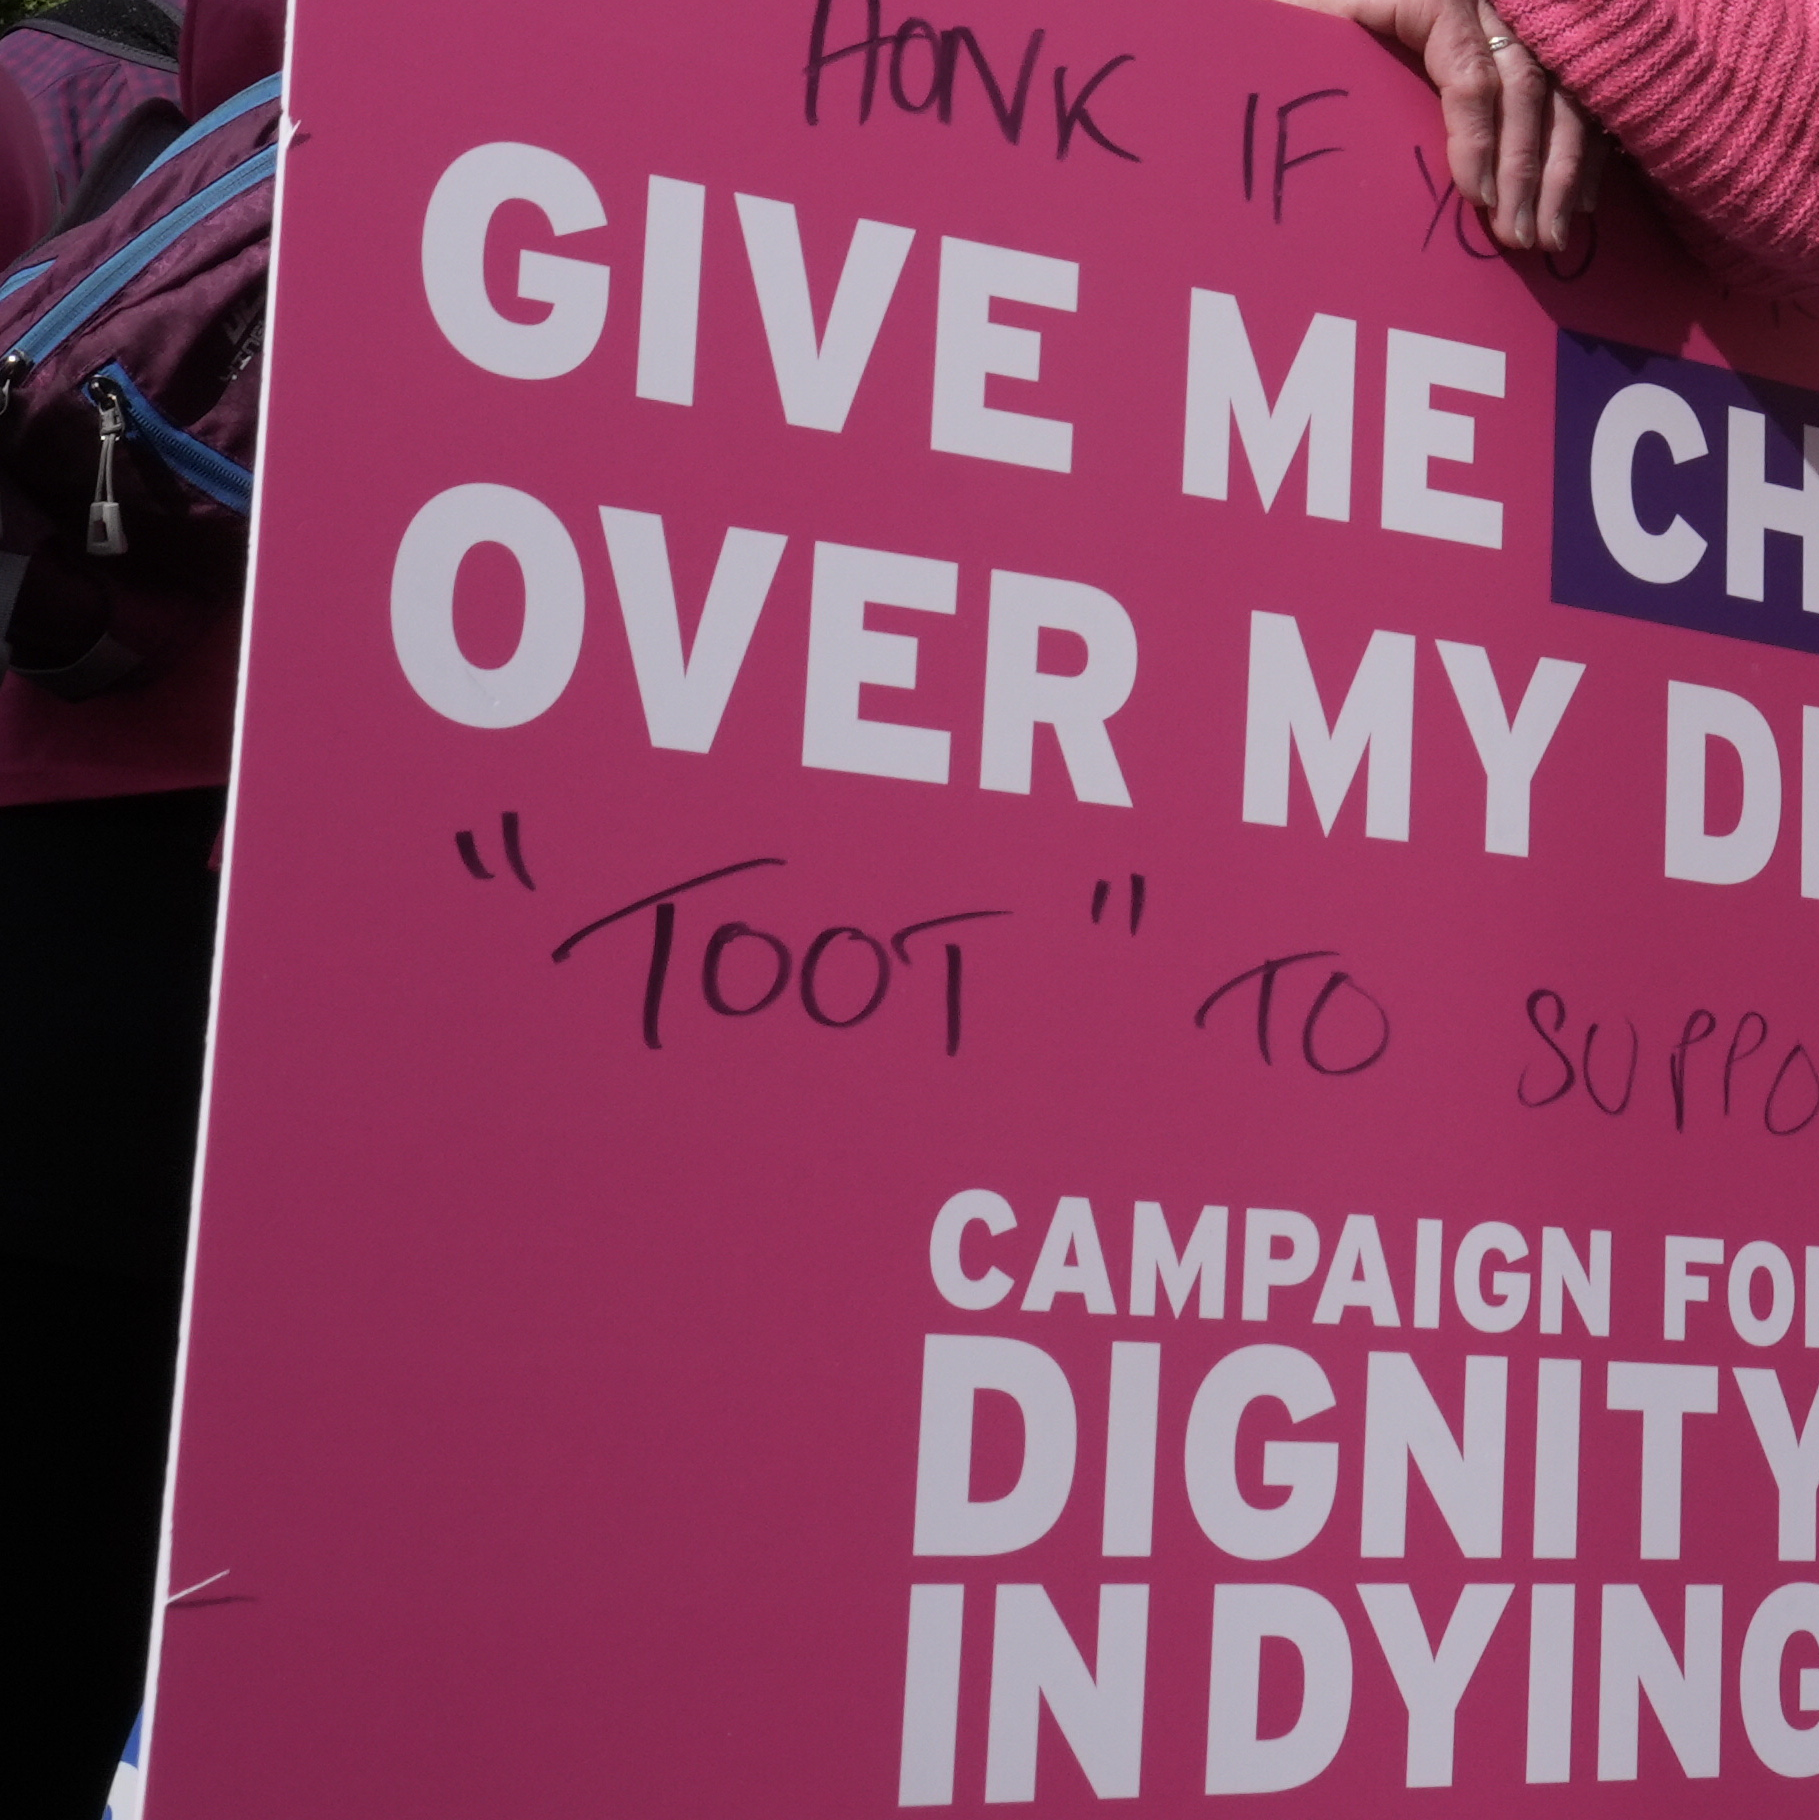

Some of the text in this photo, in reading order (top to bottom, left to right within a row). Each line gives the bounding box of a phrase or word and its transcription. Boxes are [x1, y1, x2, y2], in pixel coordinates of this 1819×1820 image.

[1243, 89, 1349, 225] IF
[420, 141, 1081, 474] GIVE
[1181, 288, 1506, 551] ME
[391, 481, 1139, 809] OVER
[1242, 610, 1586, 859] MY
[1195, 951, 1391, 1076] TO
[929, 1188, 1612, 1337] CAMPAIGN
[898, 1582, 1150, 1807] IN
